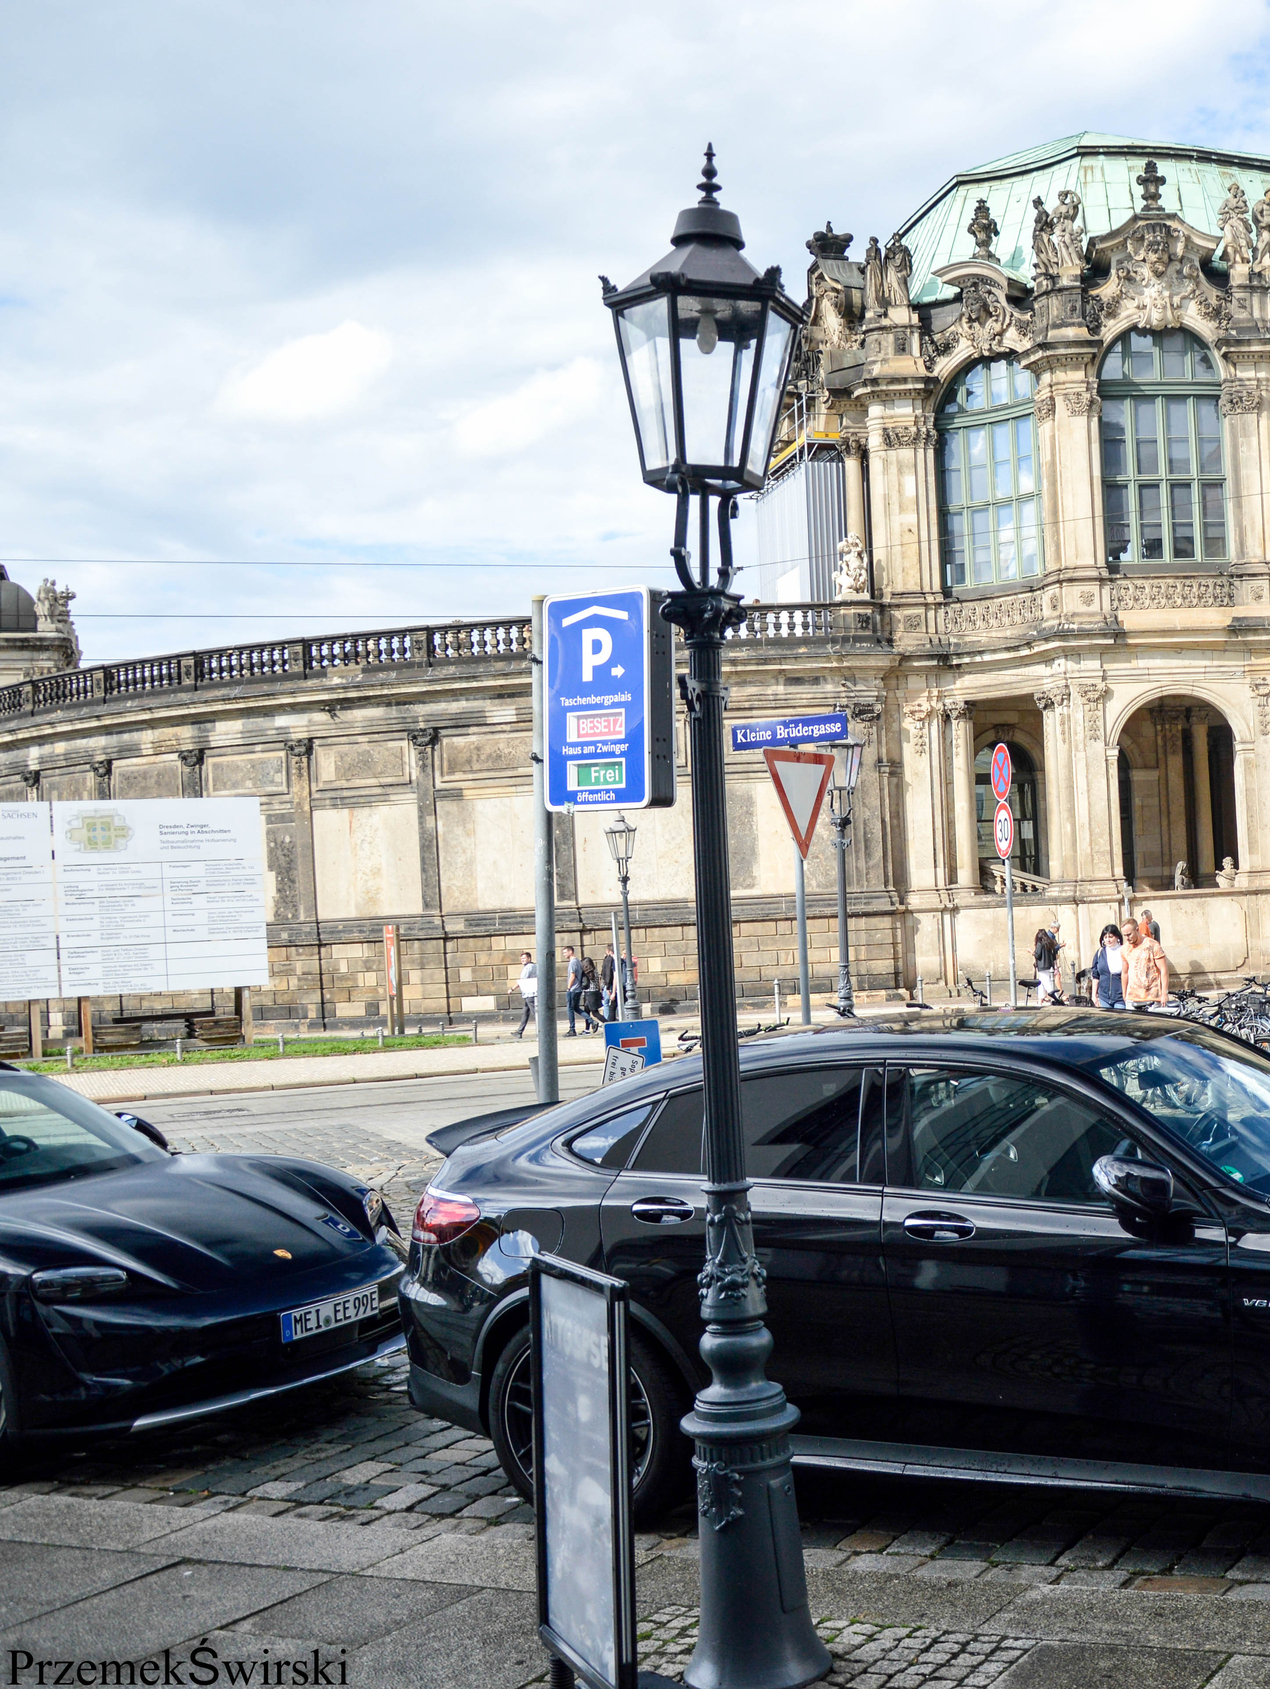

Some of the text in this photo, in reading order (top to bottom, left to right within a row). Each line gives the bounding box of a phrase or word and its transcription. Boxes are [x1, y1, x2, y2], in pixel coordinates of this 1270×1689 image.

[582, 627, 613, 682] P
[560, 691, 632, 707] Taschenbergpalais
[580, 716, 623, 734] BESETZ
[736, 722, 842, 743] Kleine Brüdergasse
[562, 743, 629, 755] Haus am Zwinger
[591, 765, 619, 783] Frei
[577, 791, 616, 802] öffentlich
[998, 817, 1009, 843] 30
[610, 1055, 619, 1069] frei
[293, 1290, 378, 1336] MEI EE 99E
